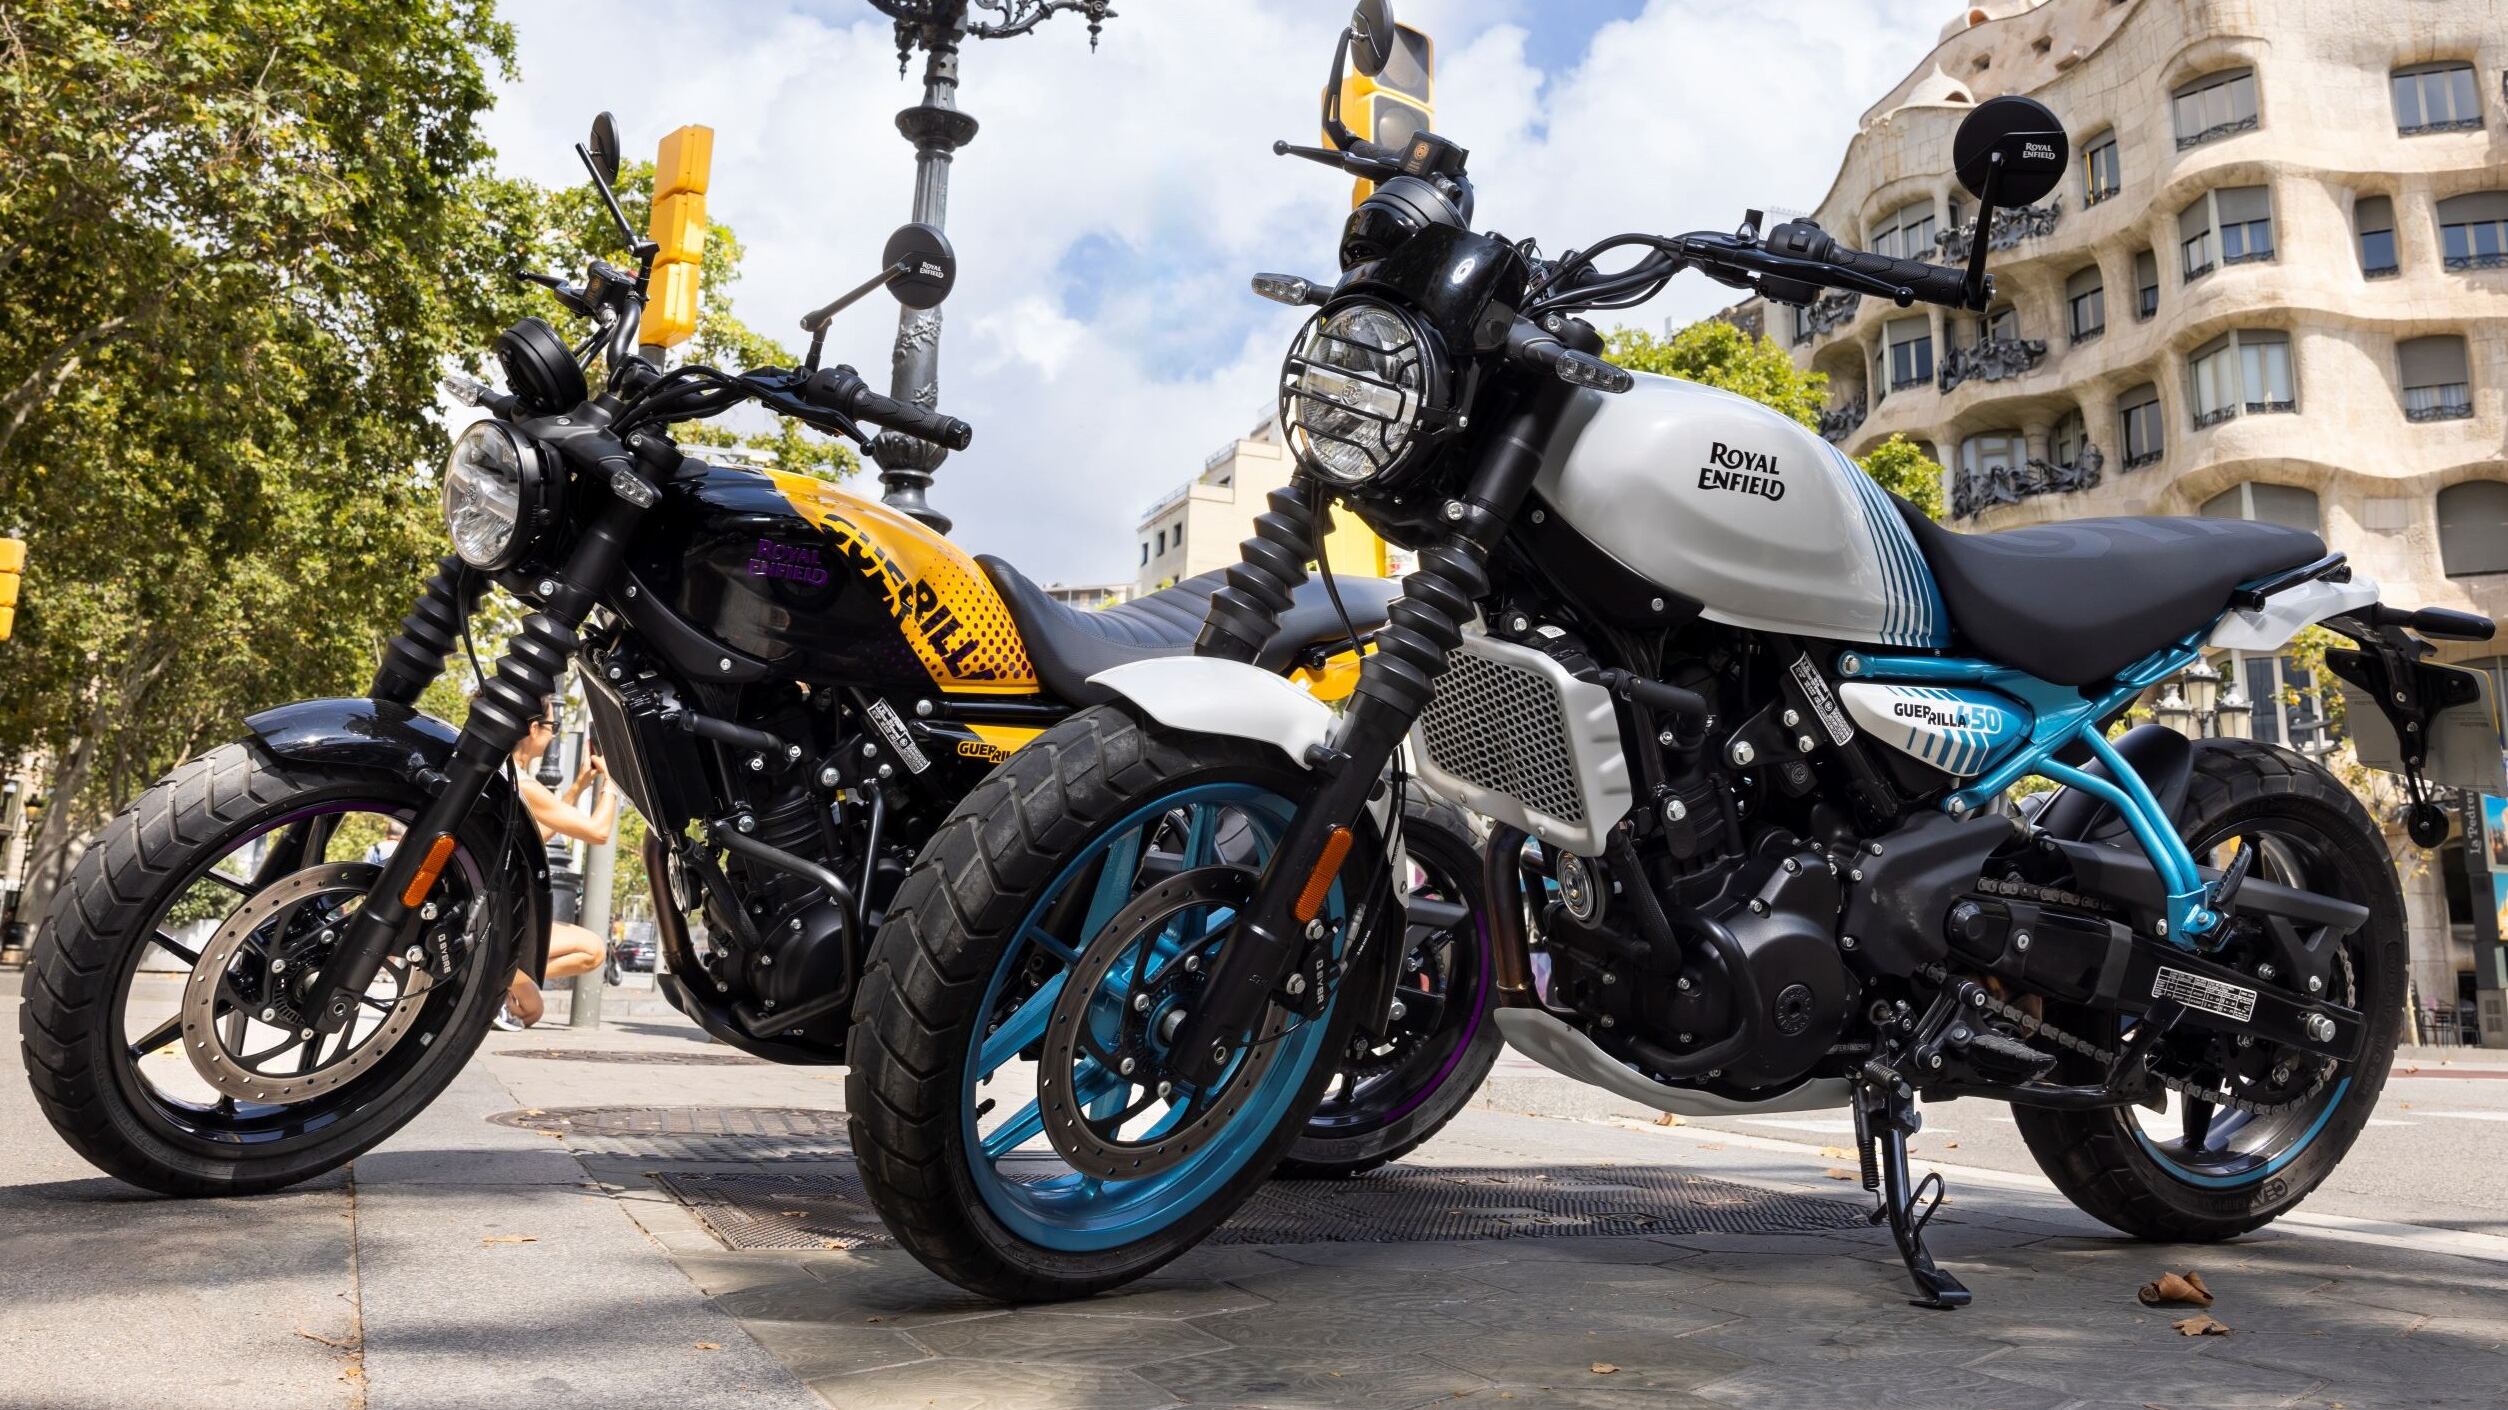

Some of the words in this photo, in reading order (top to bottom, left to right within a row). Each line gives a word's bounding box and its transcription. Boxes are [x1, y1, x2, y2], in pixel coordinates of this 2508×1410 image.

[2022, 151, 2056, 160] ENFIELD
[2025, 142, 2052, 152] ROYAL
[919, 267, 944, 279] ENFIELD
[922, 261, 942, 272] ROYAL
[1709, 441, 1780, 475] ROYAL
[1697, 467, 1785, 501] ENFIELD
[757, 538, 822, 564] ROYAL
[747, 558, 829, 587] ENFIELD
[1893, 702, 1967, 728] GUERRILLA
[439, 941, 452, 975] BYBRE
[1316, 970, 1325, 1010] BYBR
